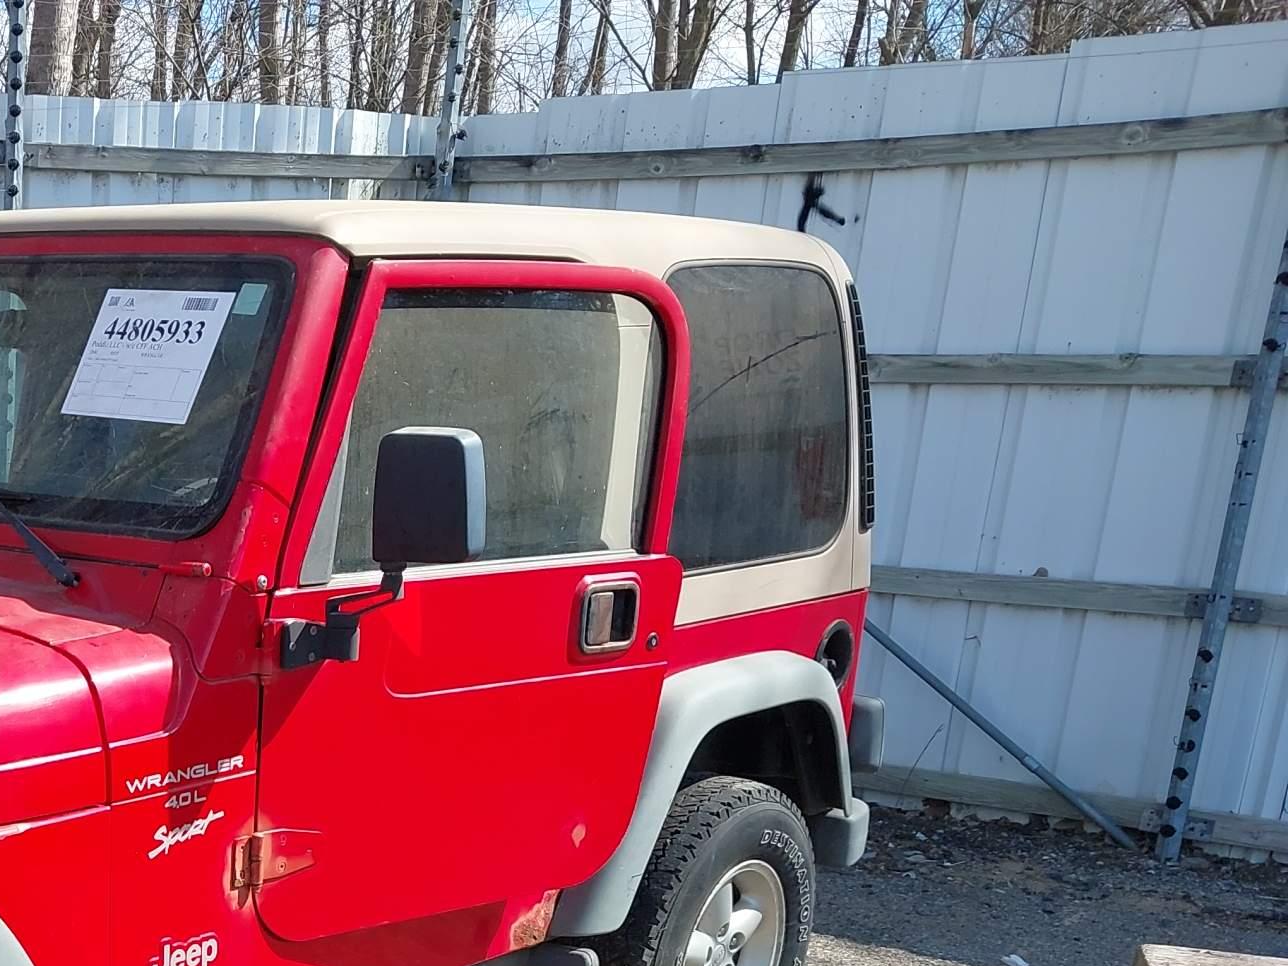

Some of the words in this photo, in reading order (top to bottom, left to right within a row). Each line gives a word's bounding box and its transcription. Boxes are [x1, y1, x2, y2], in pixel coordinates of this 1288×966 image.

[103, 317, 206, 345] 44805933
[125, 754, 244, 794] WRANGLER
[760, 828, 812, 942] DESTINATION
